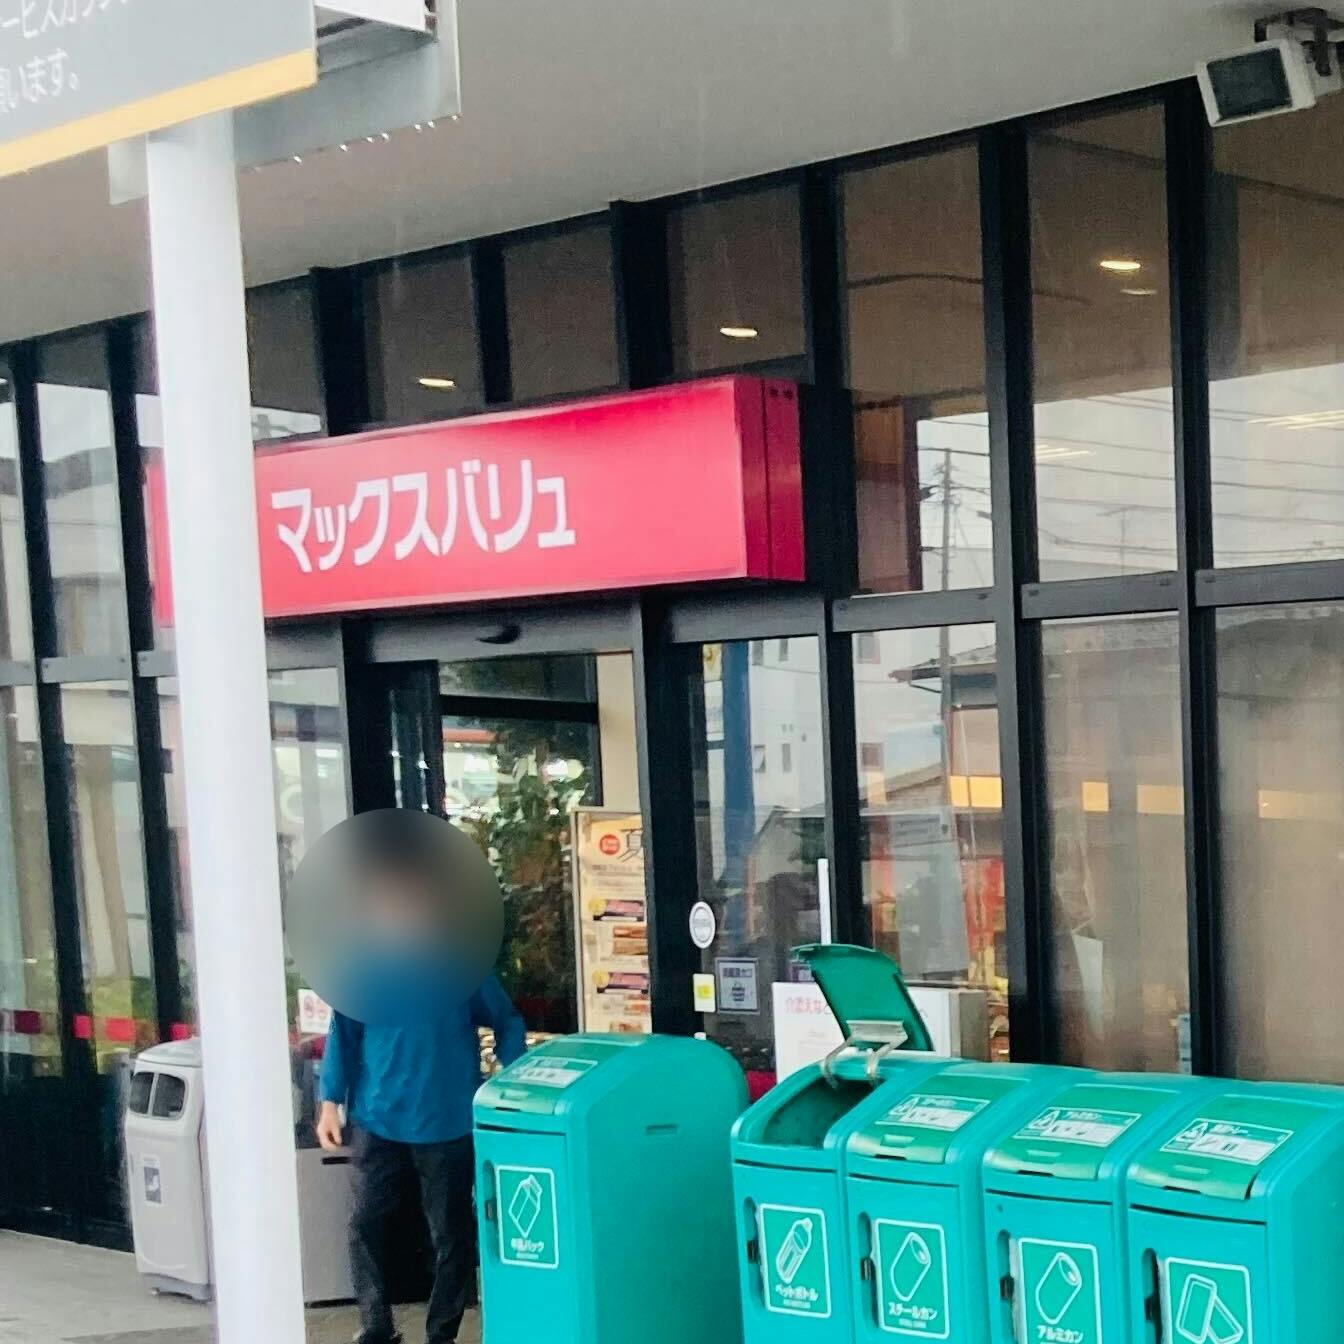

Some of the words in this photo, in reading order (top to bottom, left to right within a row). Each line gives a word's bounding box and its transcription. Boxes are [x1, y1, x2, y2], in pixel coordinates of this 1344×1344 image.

[271, 458, 576, 573] マックスバリュ
[774, 1283, 819, 1302] ペットボトル
[887, 1301, 938, 1321] スチールカン
[1036, 1324, 1085, 1344] アルミカン
